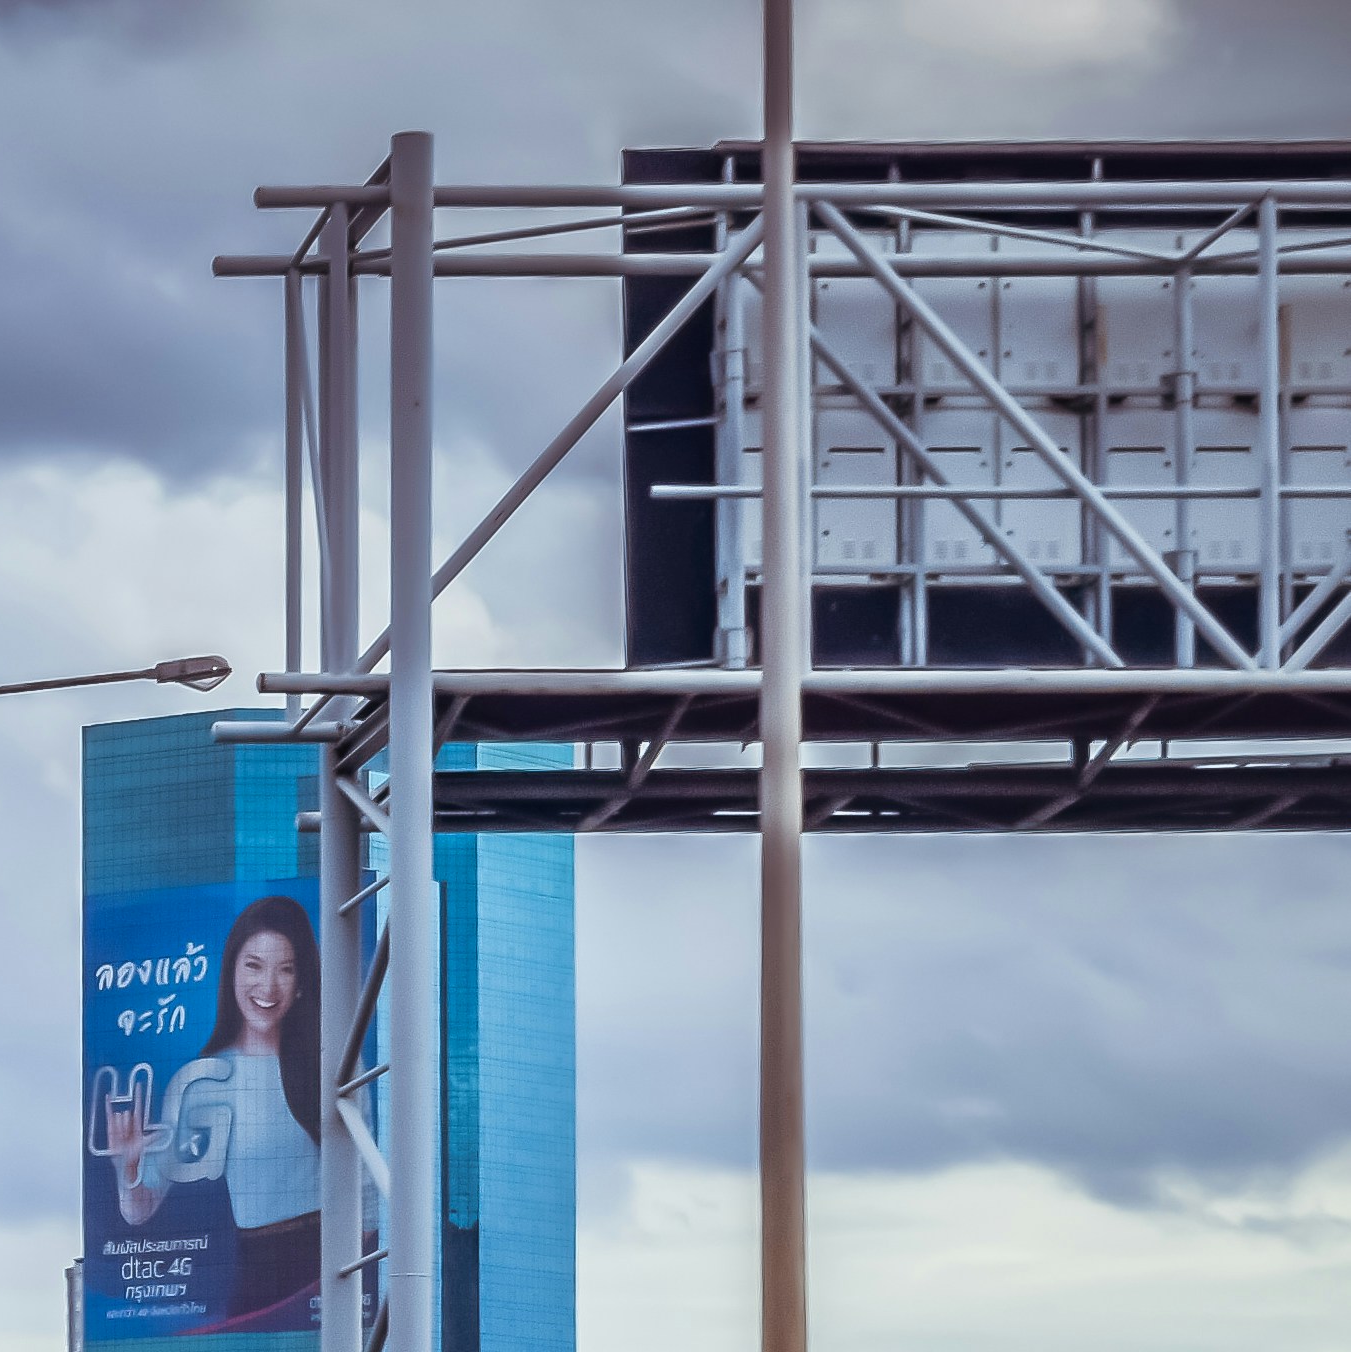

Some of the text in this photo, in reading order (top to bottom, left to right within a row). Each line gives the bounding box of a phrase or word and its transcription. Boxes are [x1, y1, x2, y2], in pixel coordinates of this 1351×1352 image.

[95, 941, 208, 991] ลองแล้ว
[117, 993, 187, 1037] จะรัก
[121, 1256, 193, 1280] dtac 4G
[125, 1283, 188, 1304] กรุงเทพฯ
